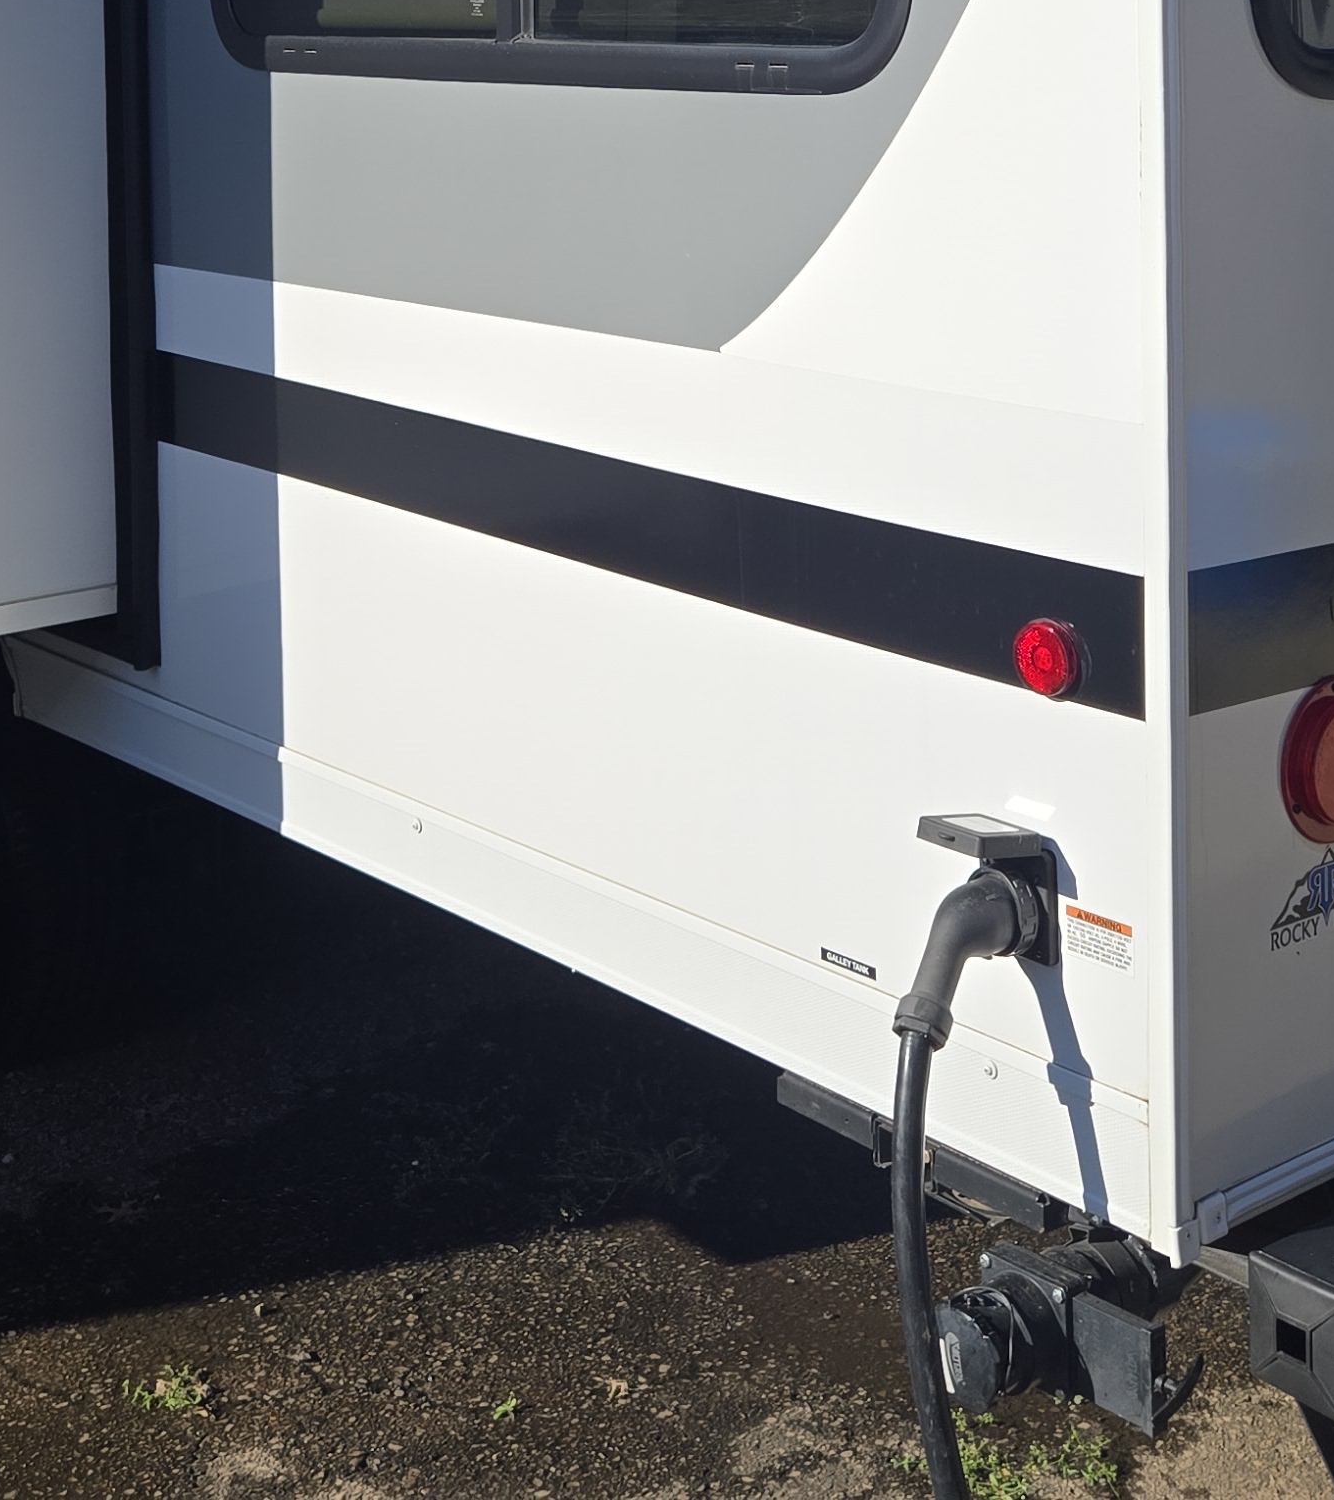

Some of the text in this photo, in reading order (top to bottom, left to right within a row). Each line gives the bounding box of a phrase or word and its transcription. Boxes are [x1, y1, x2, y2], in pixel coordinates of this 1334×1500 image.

[1083, 911, 1122, 933] WARNING
[1270, 916, 1321, 952] ROCKY
[826, 951, 870, 976] GALLEY TANK
